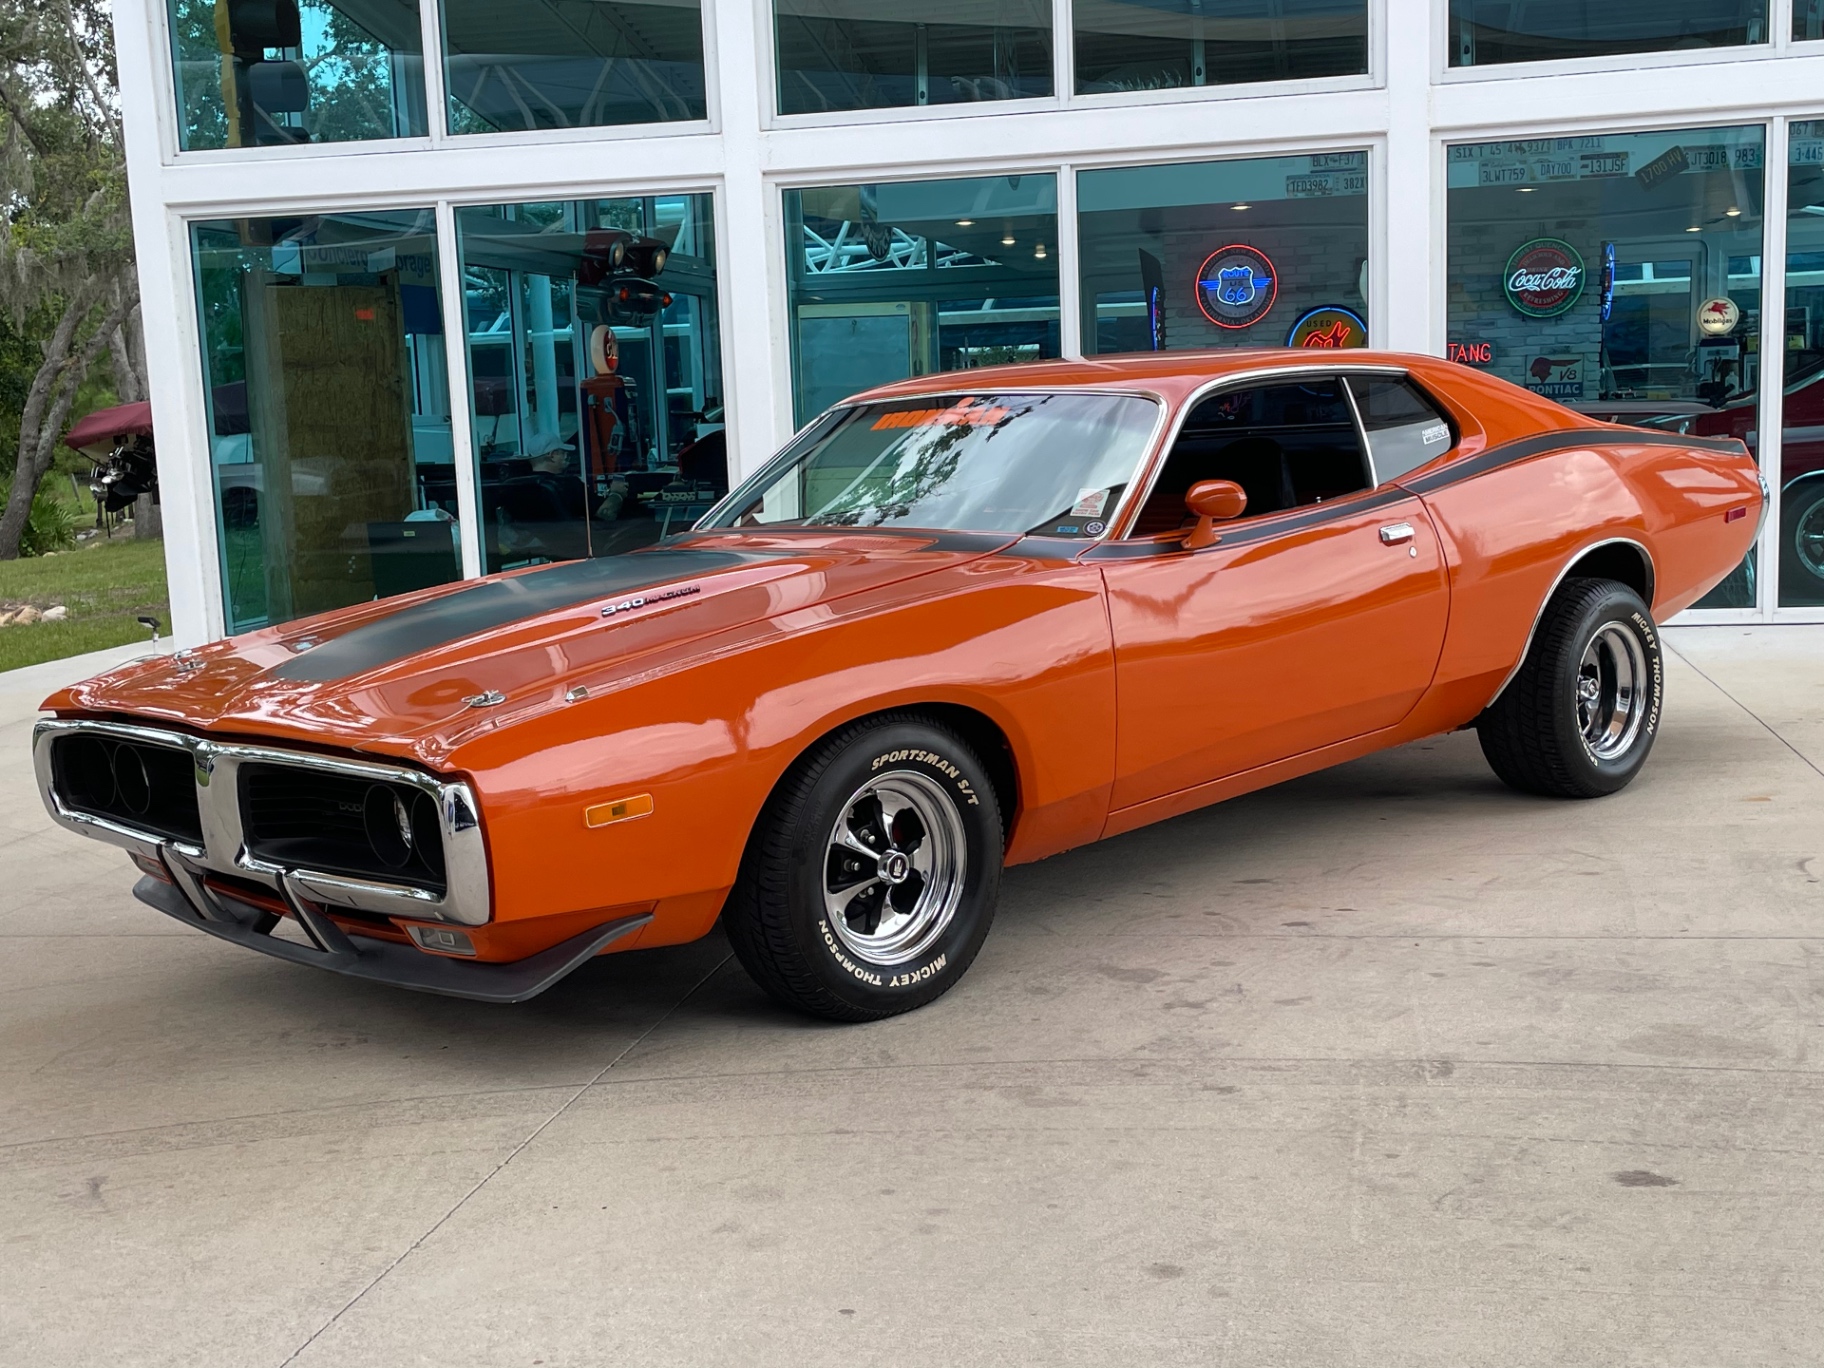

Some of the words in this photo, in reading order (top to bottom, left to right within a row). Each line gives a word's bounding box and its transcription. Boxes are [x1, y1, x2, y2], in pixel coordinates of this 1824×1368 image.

[1455, 146, 1473, 159] SIX
[1735, 148, 1755, 162] 983
[1482, 168, 1526, 183] 3LWT759
[1540, 162, 1572, 176] DAY700
[1640, 160, 1668, 184] 1700
[1666, 149, 1683, 166] HV
[306, 246, 370, 272] Concierg
[1222, 269, 1250, 278] ROUTE
[1508, 266, 1582, 291] Coca-Cola
[1225, 286, 1247, 302] 66
[1306, 319, 1332, 328] USED
[1448, 343, 1492, 363] TANG
[1559, 367, 1577, 382] V8
[1528, 384, 1580, 395] PONTIAC
[601, 597, 644, 617] 340
[1631, 612, 1657, 650] MICKEY
[1646, 656, 1661, 735] THOMPSON
[871, 749, 960, 779] SPORTSMAN
[957, 779, 979, 806] S/T
[818, 919, 882, 986] THOMPSON
[889, 953, 947, 987] MICKEY
